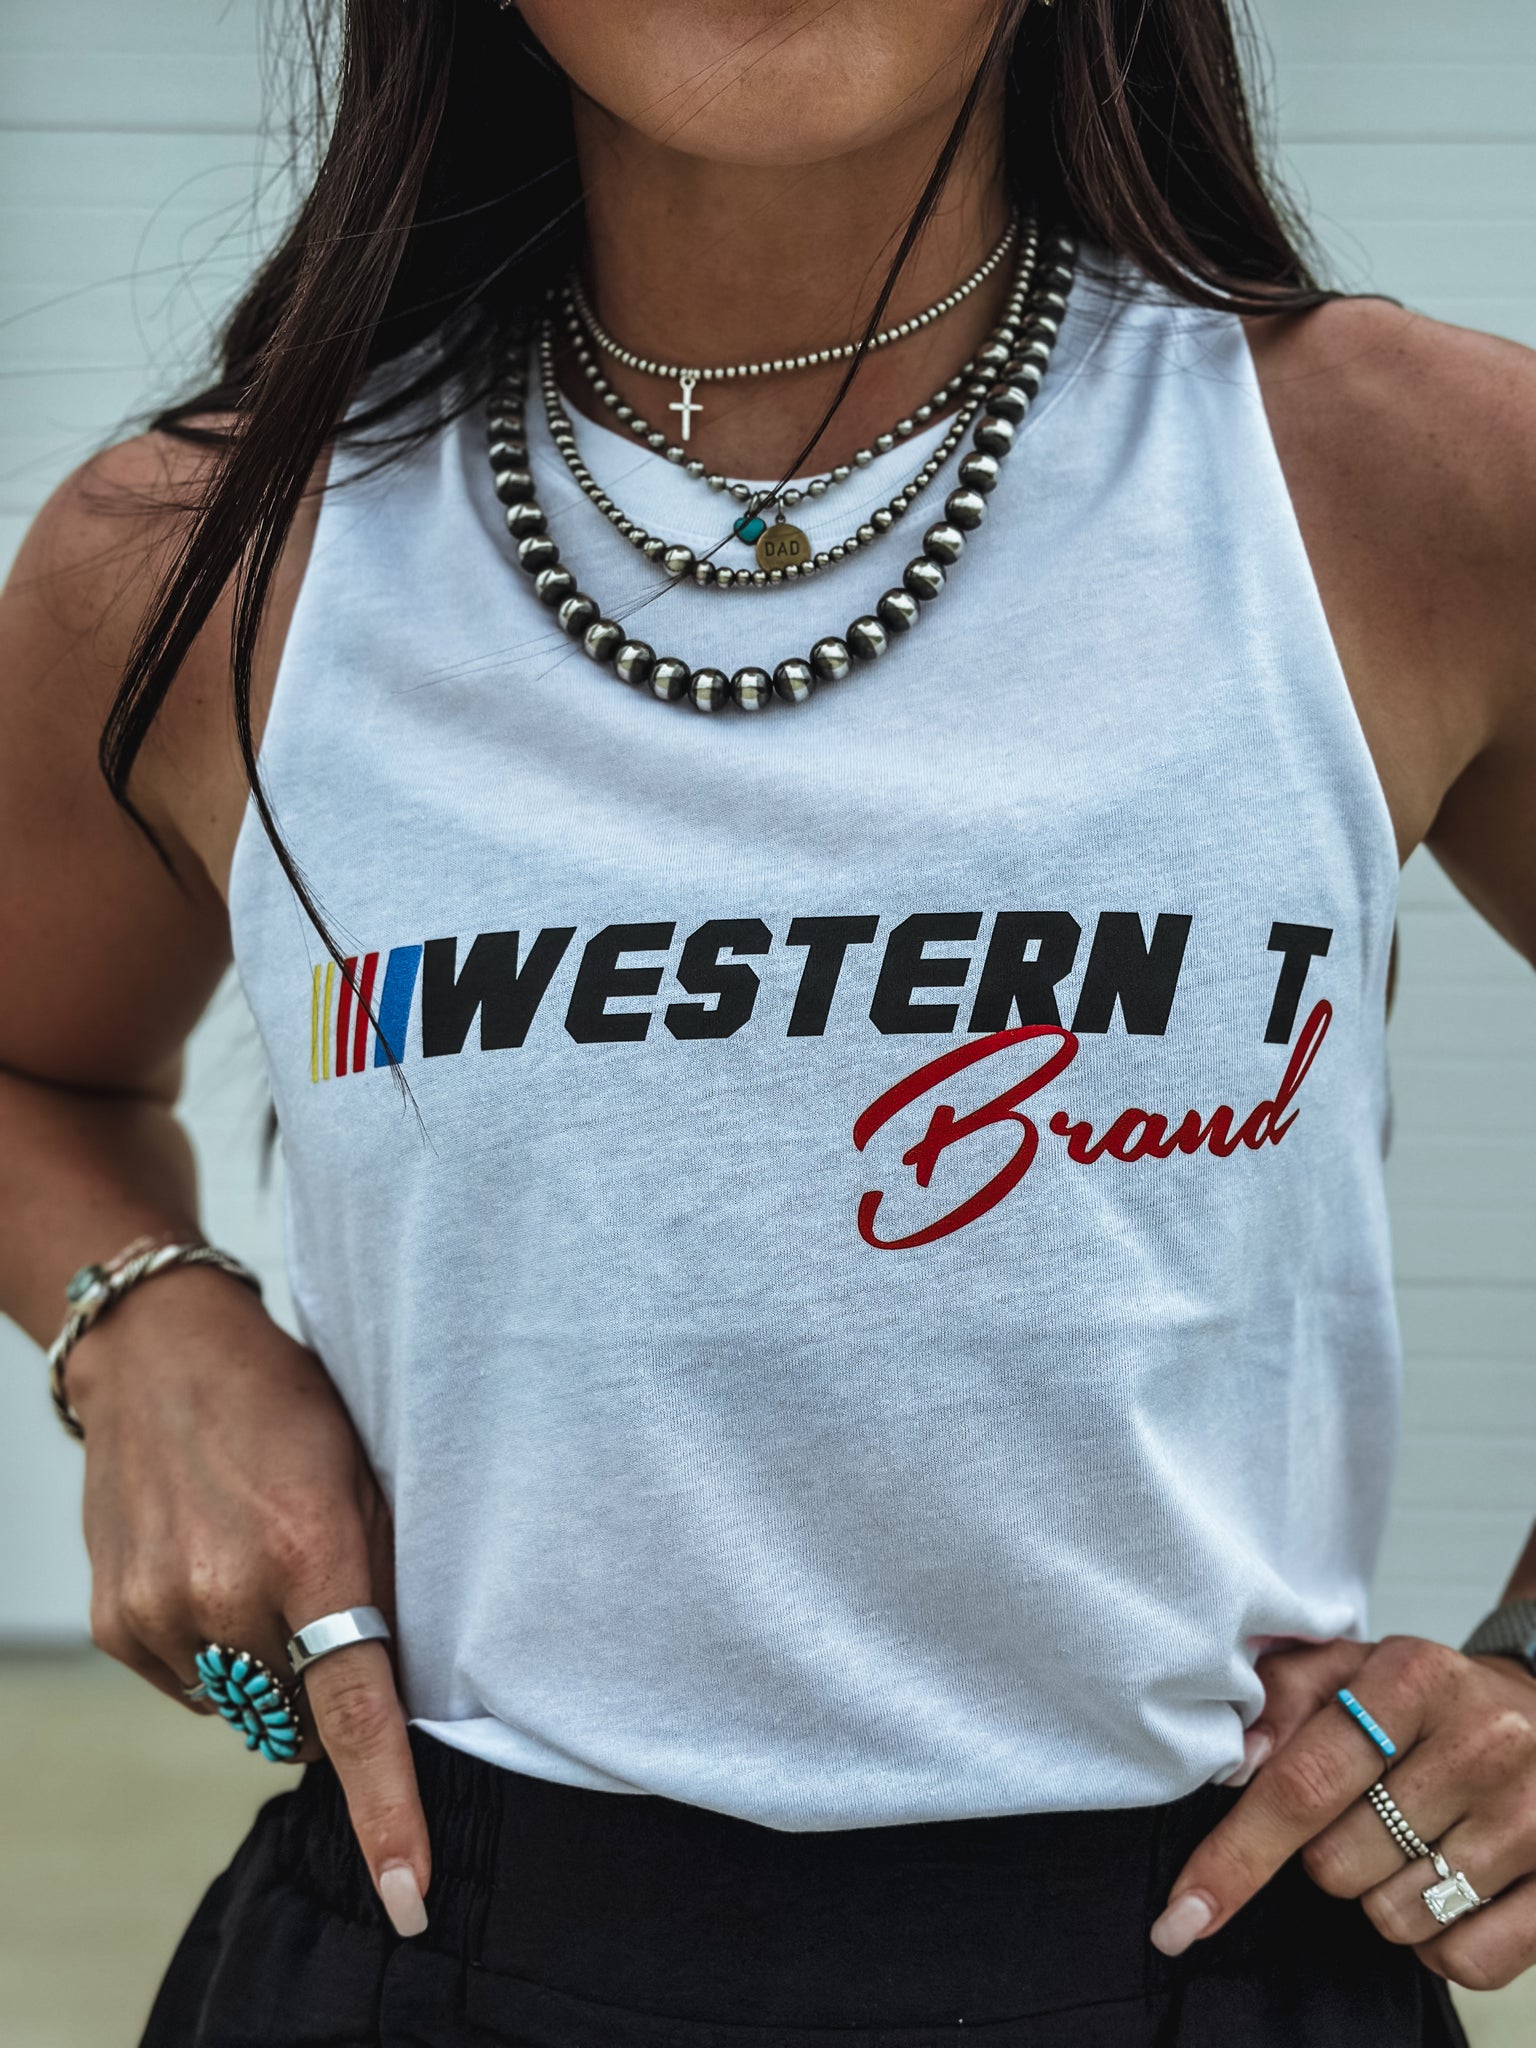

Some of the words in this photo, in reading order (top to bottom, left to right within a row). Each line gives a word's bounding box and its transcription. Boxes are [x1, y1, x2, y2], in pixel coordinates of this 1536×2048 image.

[764, 541, 800, 557] DAD
[422, 911, 1191, 1058] WESTERN
[1263, 922, 1333, 1045] T
[853, 999, 1333, 1250] Brand
